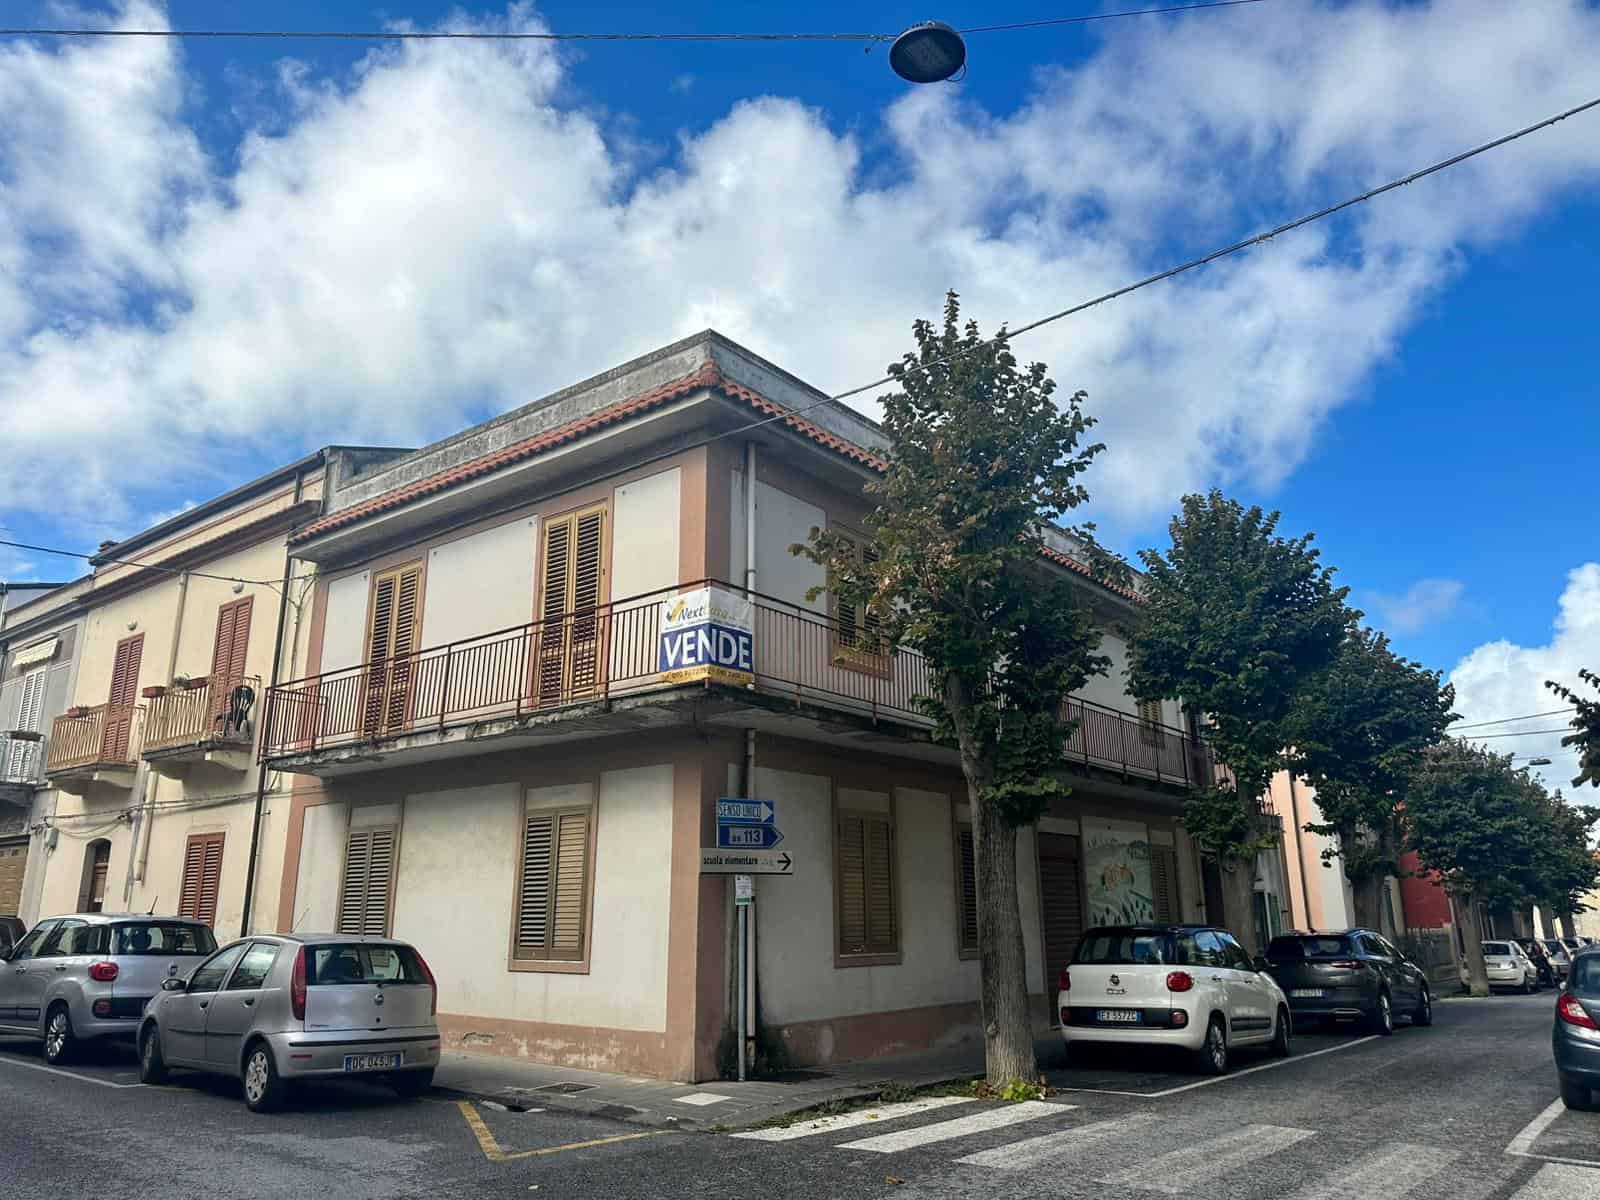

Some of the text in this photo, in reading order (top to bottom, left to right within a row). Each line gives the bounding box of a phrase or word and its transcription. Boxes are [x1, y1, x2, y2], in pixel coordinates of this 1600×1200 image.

[663, 628, 751, 669] VENDE
[744, 829, 761, 844] 113
[703, 855, 723, 865] scuola
[724, 855, 758, 865] elementare
